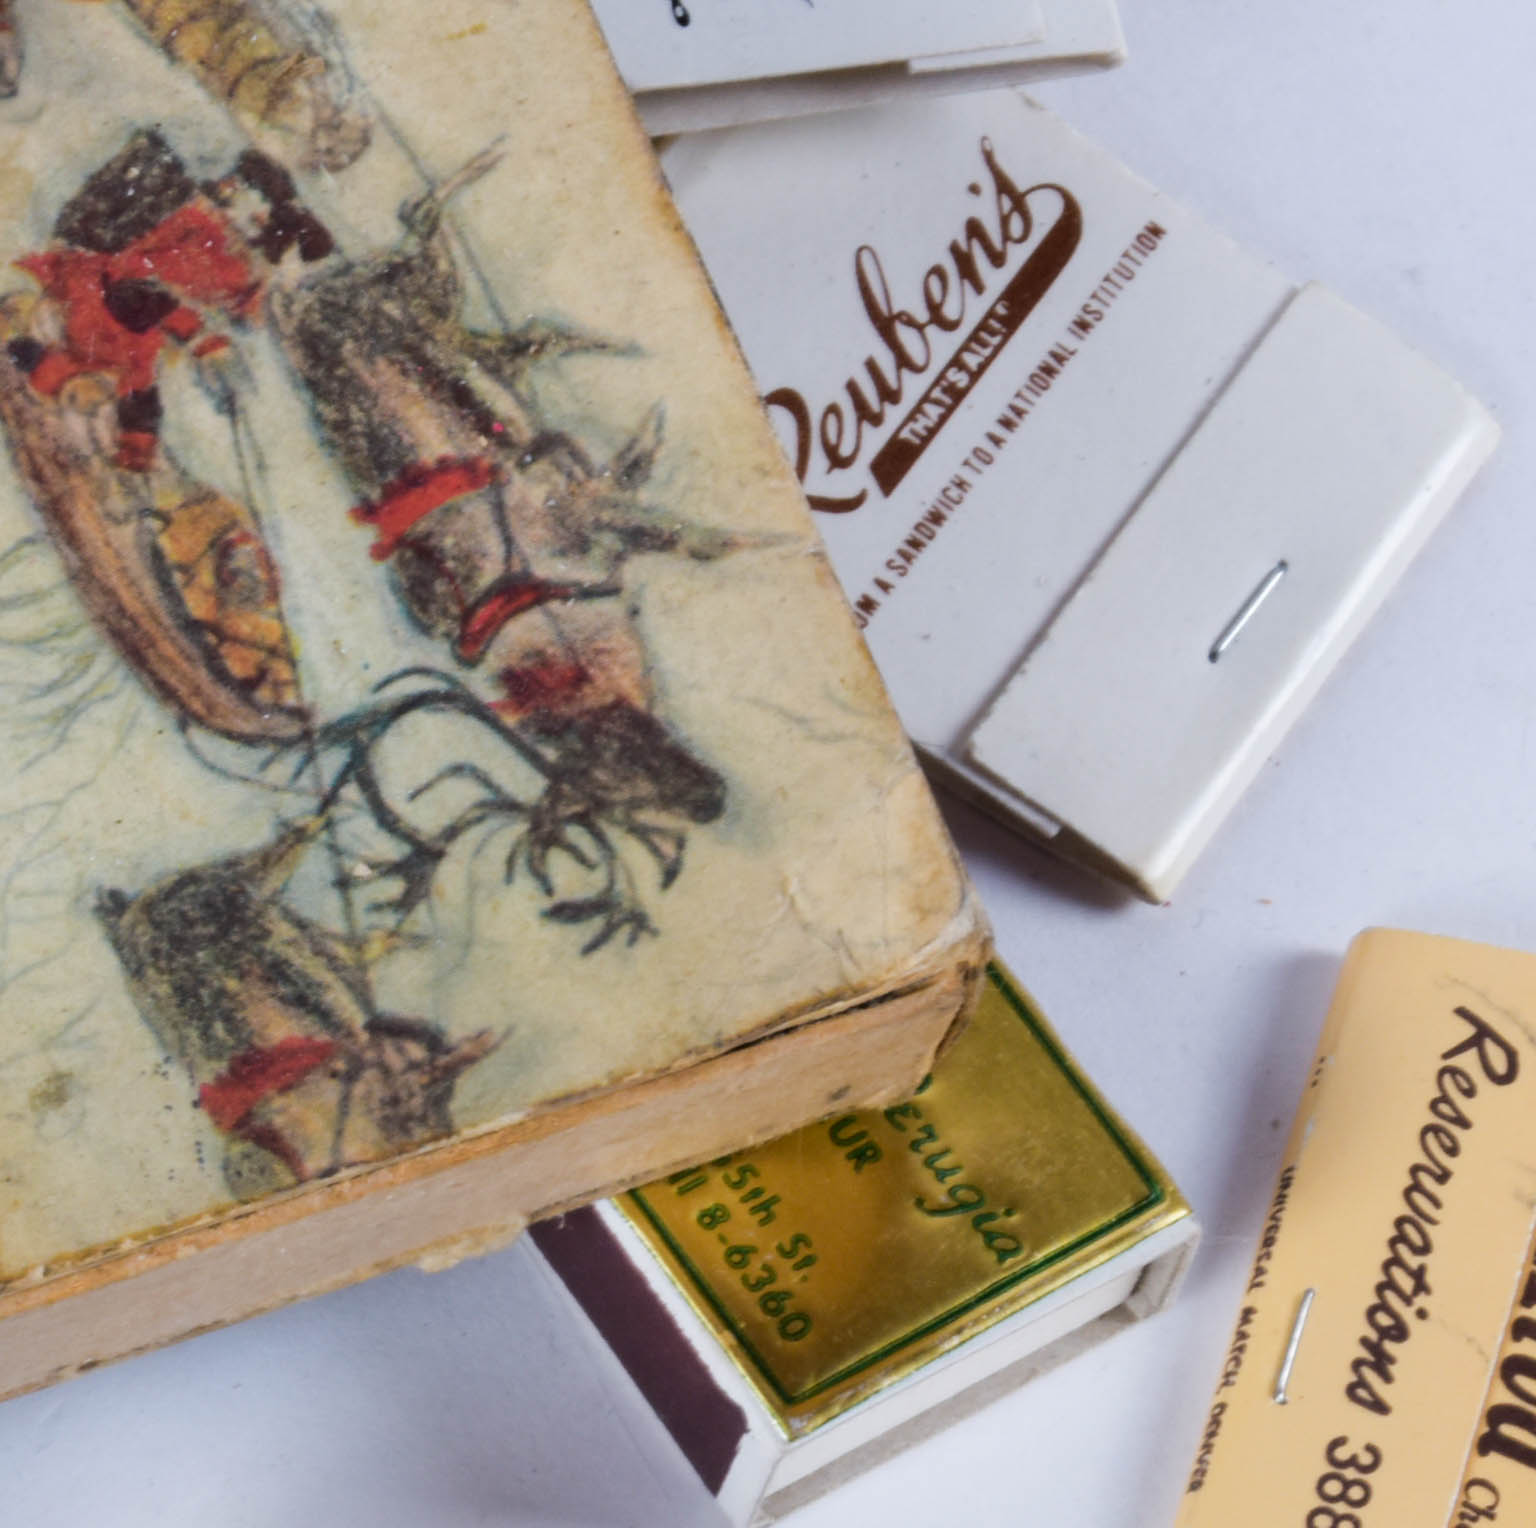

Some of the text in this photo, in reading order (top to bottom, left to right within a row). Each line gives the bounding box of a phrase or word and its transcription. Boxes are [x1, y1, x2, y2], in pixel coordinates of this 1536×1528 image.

[1067, 220, 1169, 343] INSTITUTION
[984, 430, 1008, 451] A
[994, 341, 1078, 435] NATIONAL
[961, 445, 996, 475] TO
[884, 473, 972, 577] SANDWICH
[884, 1072, 1025, 1266] erugia
[1343, 1004, 1521, 1417] Reservations
[696, 1203, 814, 1343] 8-6360
[1246, 1164, 1296, 1297] UNIVERSAL
[1184, 1400, 1229, 1495] DENVER
